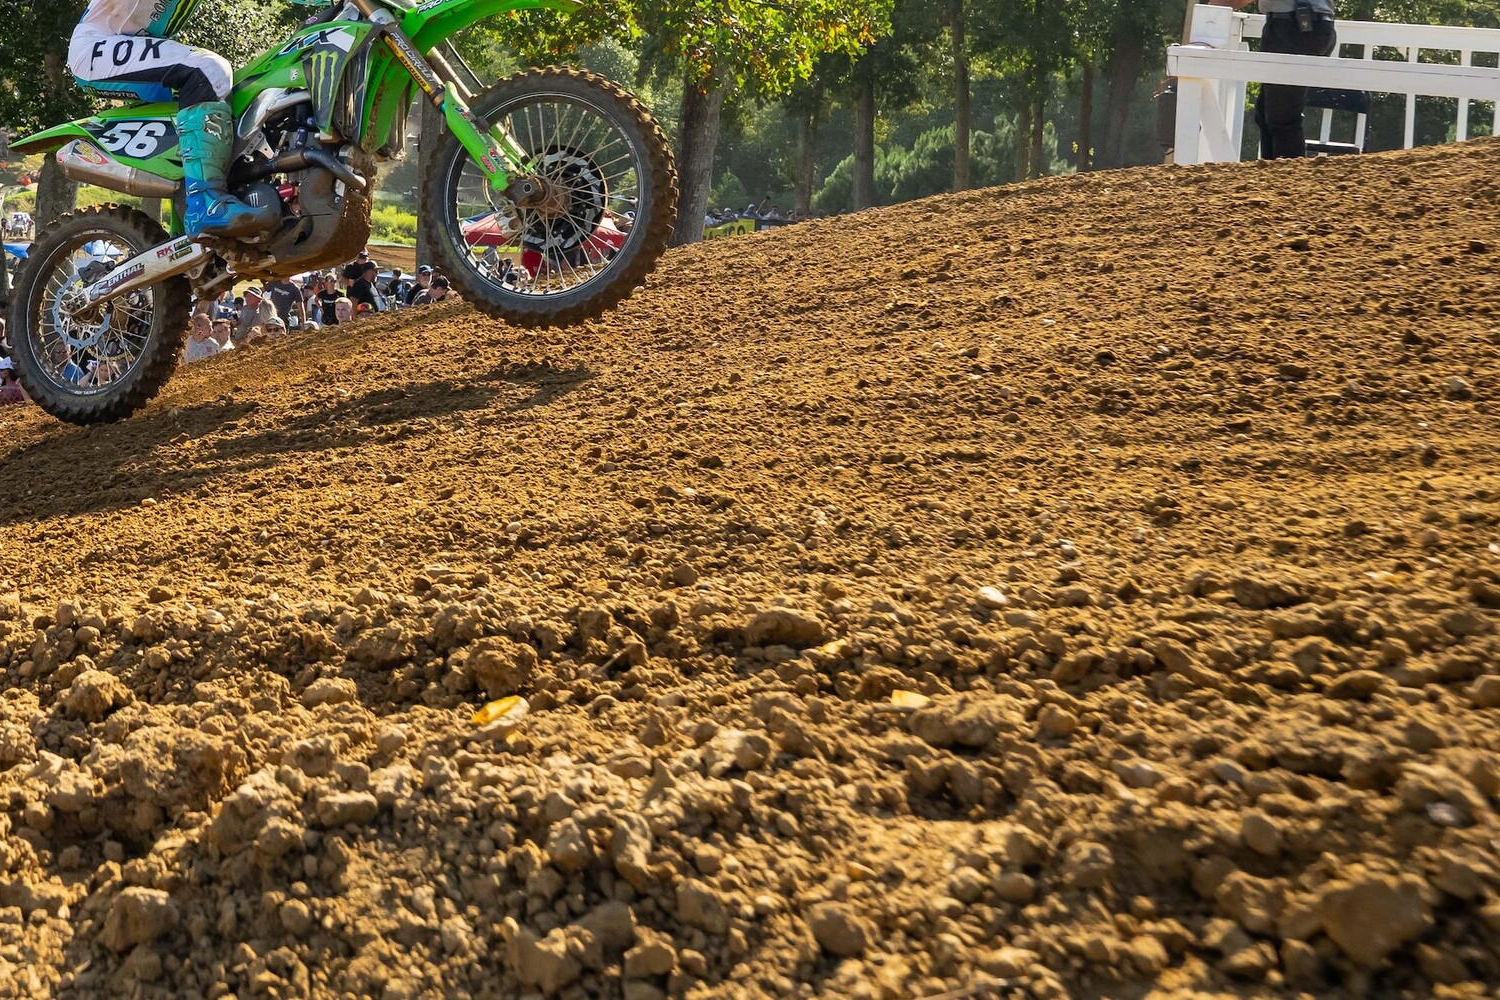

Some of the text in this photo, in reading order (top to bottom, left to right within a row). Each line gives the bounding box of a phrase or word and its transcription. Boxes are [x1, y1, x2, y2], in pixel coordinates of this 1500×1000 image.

[90, 38, 168, 71] FOX
[389, 31, 409, 54] PRO
[405, 49, 436, 83] CIRCUIT
[399, 55, 427, 87] SHOWA
[96, 90, 139, 99] MONSTER
[97, 121, 167, 158] 56
[156, 245, 174, 259] RK
